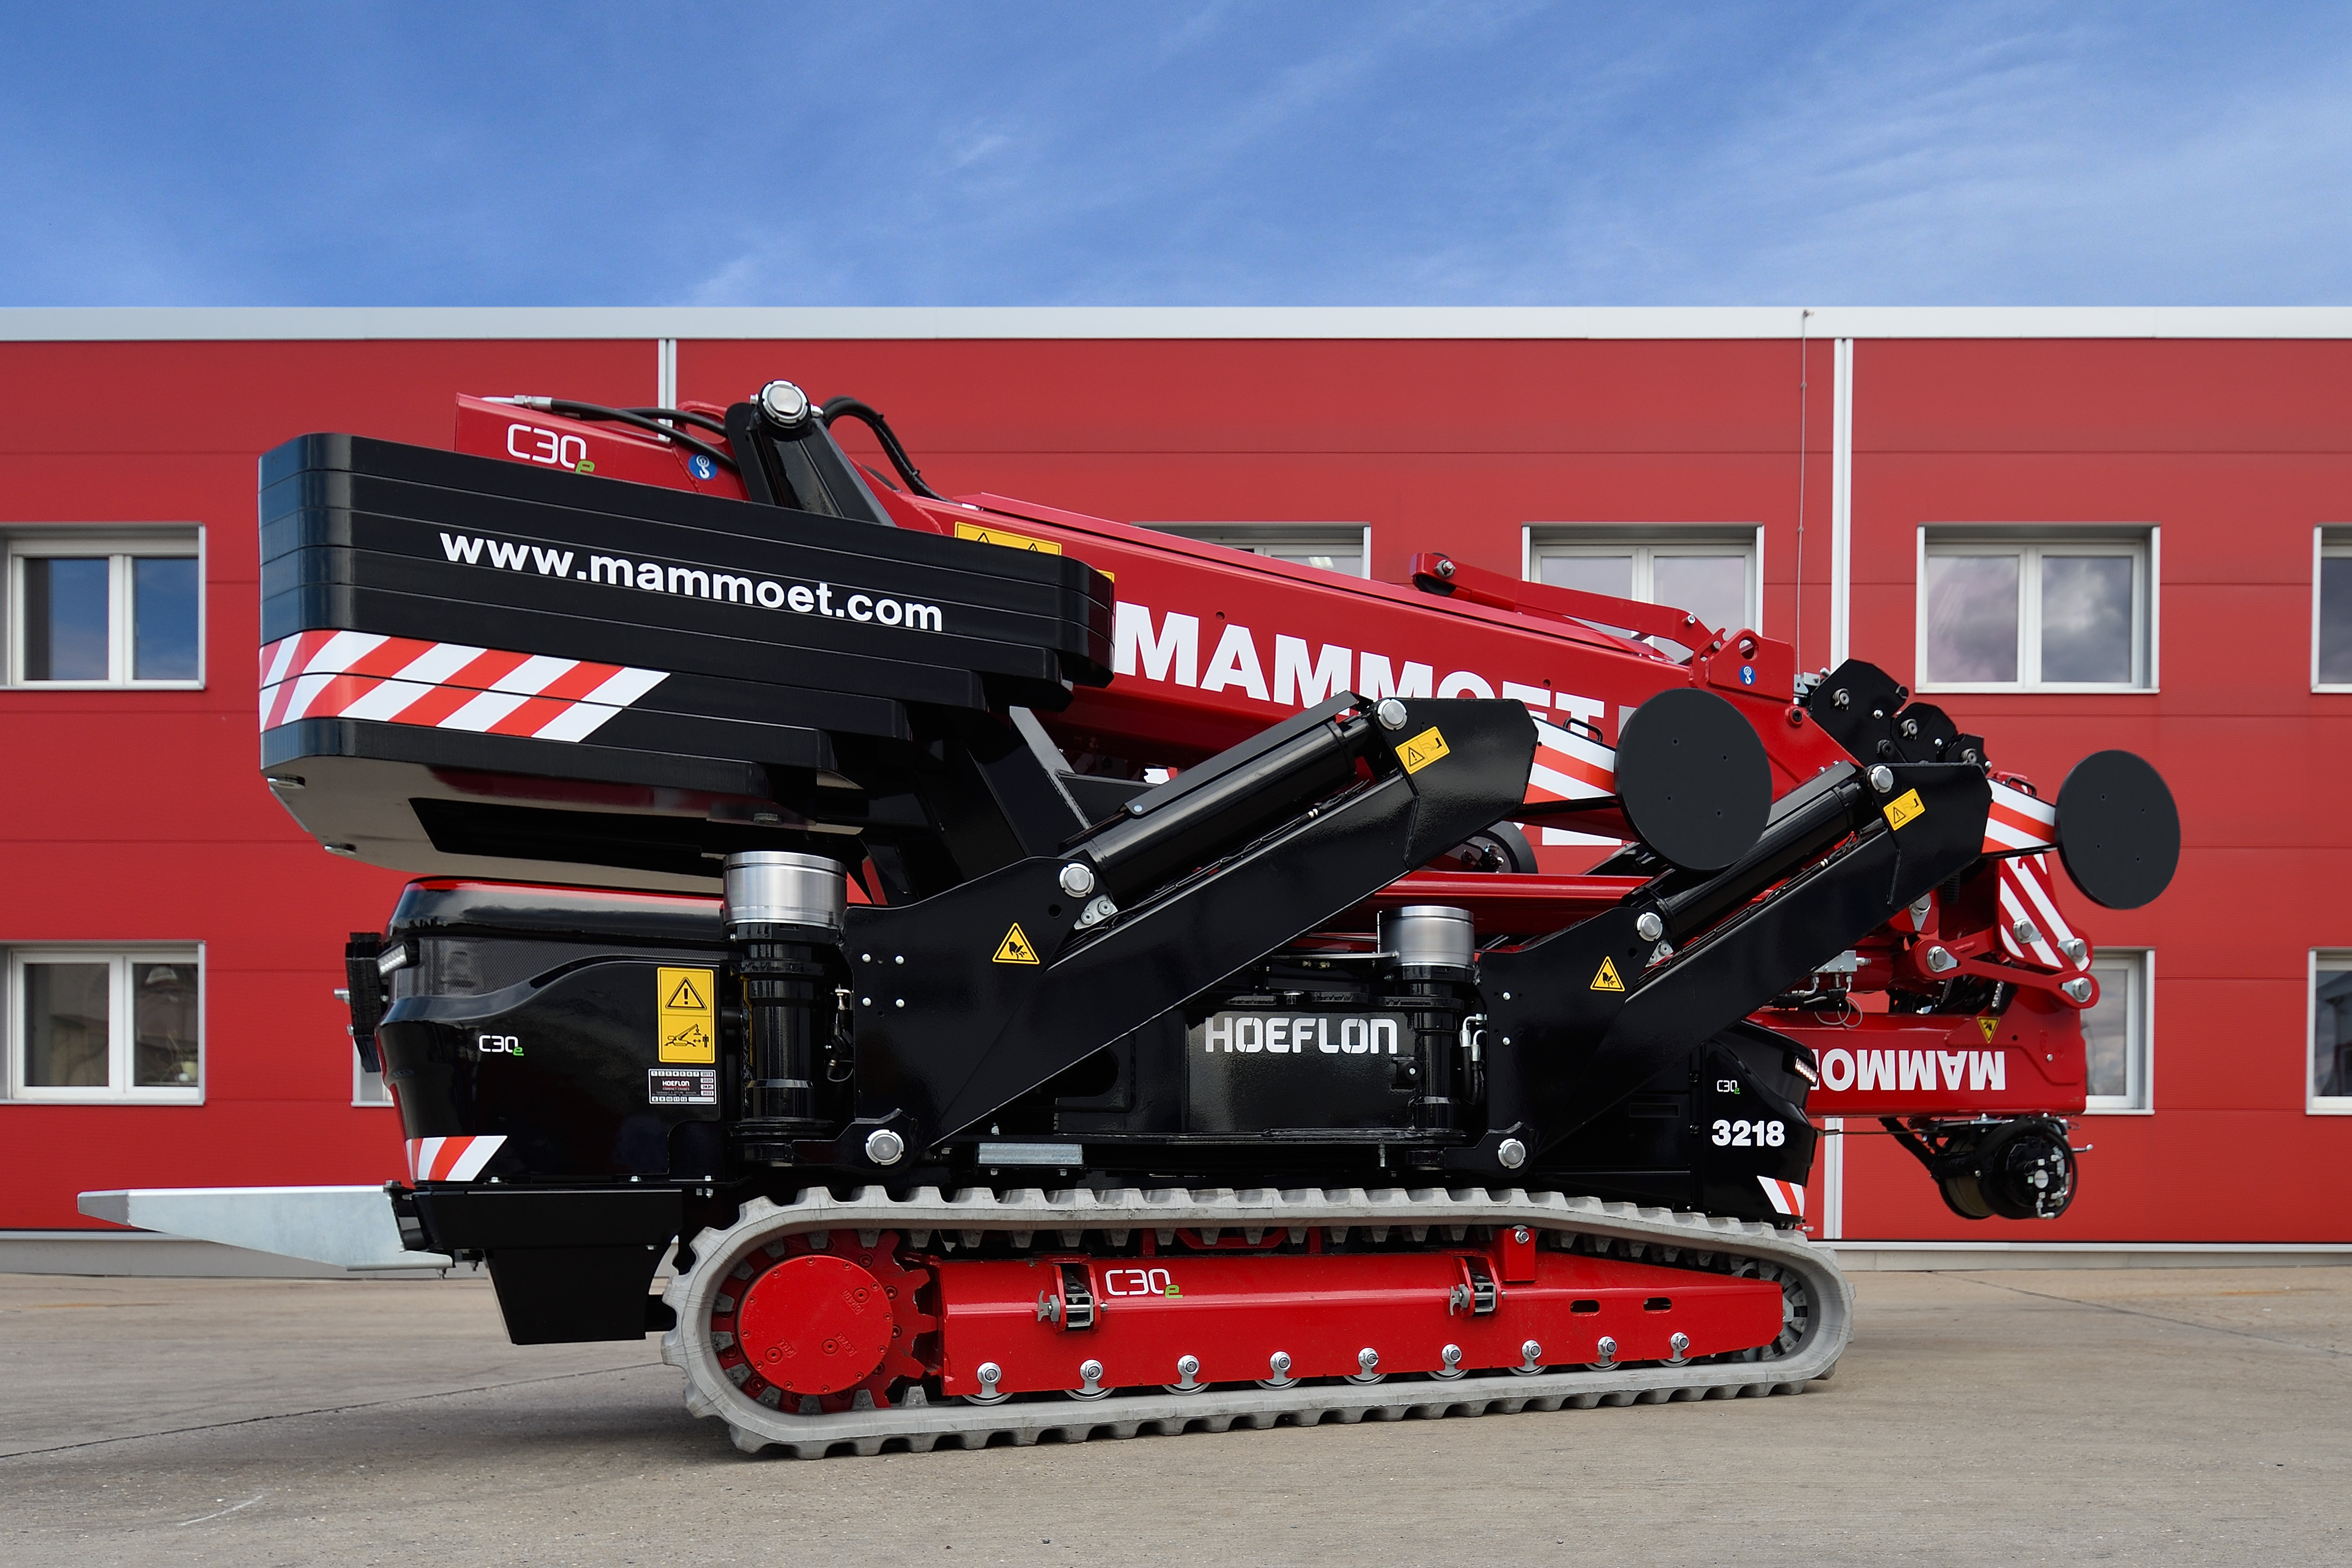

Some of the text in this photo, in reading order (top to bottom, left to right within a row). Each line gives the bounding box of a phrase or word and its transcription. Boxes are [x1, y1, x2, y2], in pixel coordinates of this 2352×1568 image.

[440, 533, 942, 632] www.mammoet.com
[479, 1035, 524, 1056] C30e
[1205, 1017, 1397, 1054] HOEFLON
[1810, 1048, 2006, 1091] MAMMO
[1712, 1119, 1785, 1147] 3218
[1106, 1268, 1183, 1299] C30e
